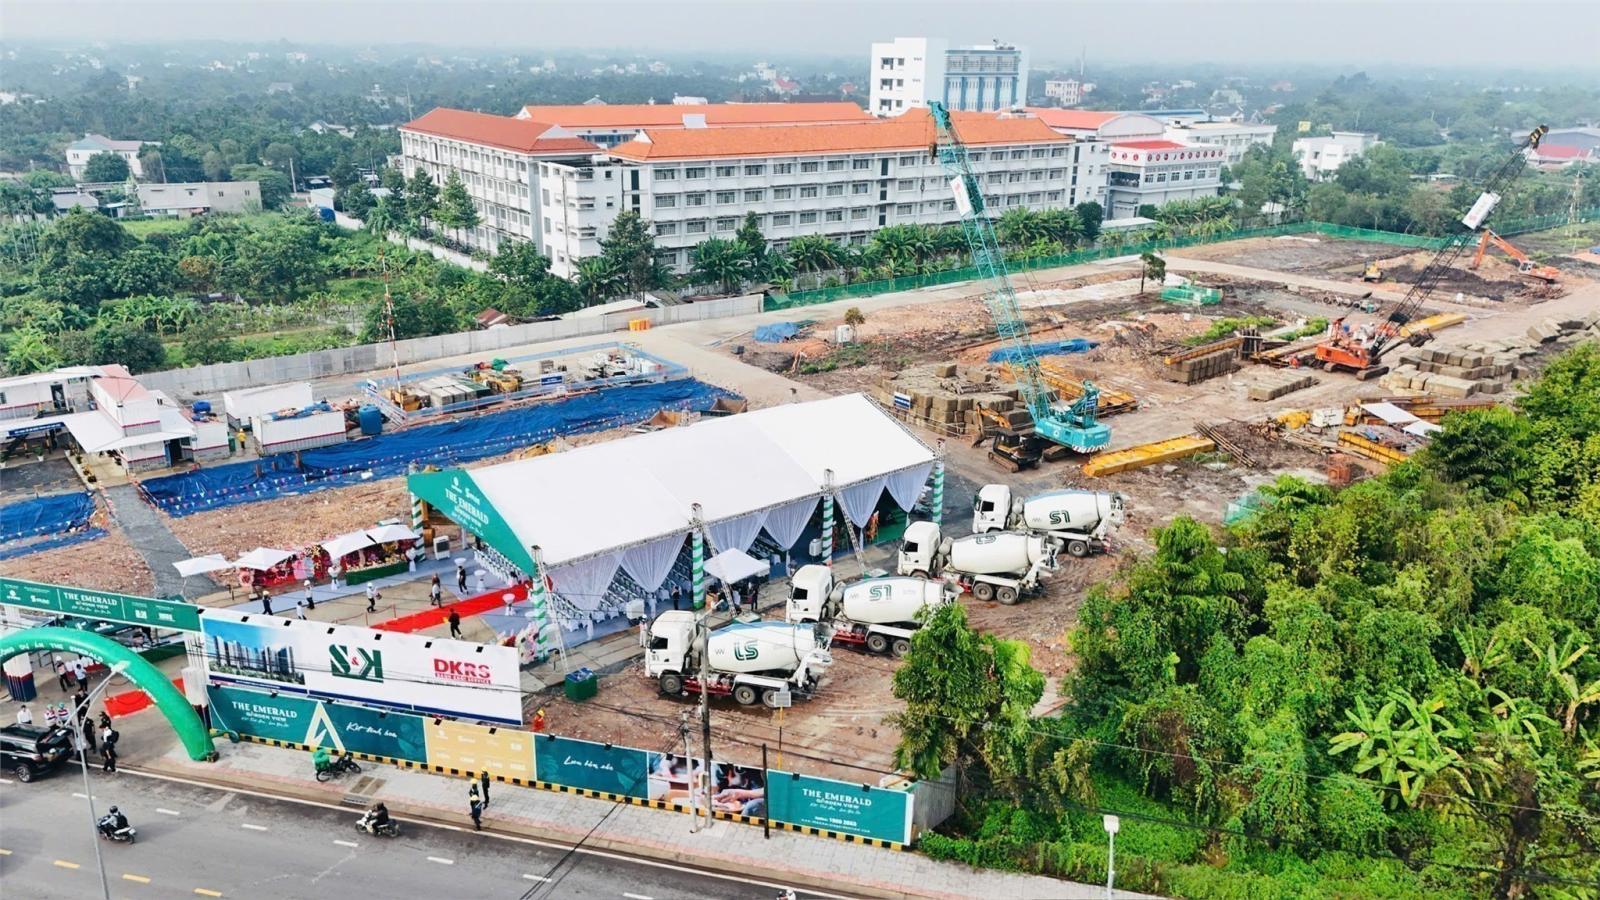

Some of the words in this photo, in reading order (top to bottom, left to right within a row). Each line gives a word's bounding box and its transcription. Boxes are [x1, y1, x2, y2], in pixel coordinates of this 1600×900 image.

[445, 488, 458, 504] THE
[458, 497, 489, 525] EMERALD
[63, 592, 80, 601] THE
[80, 594, 118, 606] EMERALD
[869, 584, 892, 602] S1
[434, 658, 490, 679] DKRS
[232, 700, 250, 711] THE
[252, 703, 298, 719] EMERALD
[802, 788, 822, 798] THE
[824, 791, 872, 807] EMERALD
[842, 802, 860, 810] VIEW
